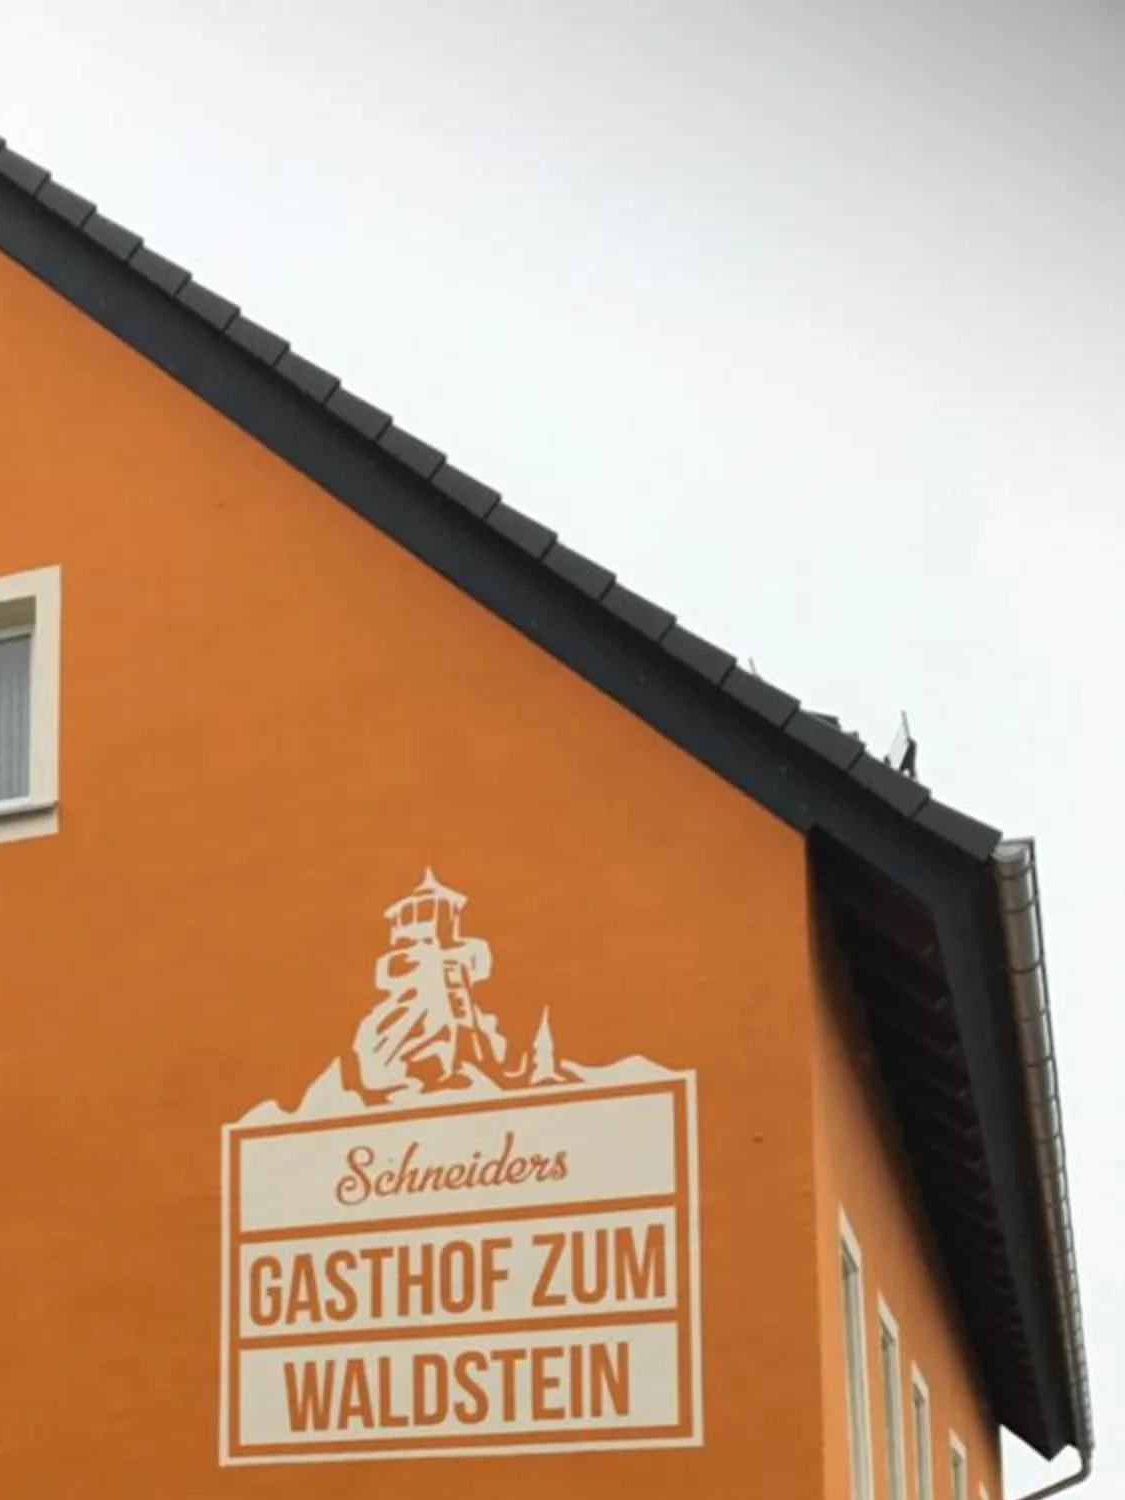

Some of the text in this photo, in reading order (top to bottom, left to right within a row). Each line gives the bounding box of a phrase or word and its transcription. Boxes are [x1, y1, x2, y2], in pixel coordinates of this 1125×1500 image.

[335, 1131, 568, 1206] Schneiders
[248, 1223, 667, 1327] GASTHOF ZUM
[283, 1341, 631, 1433] WALDSTEIN
